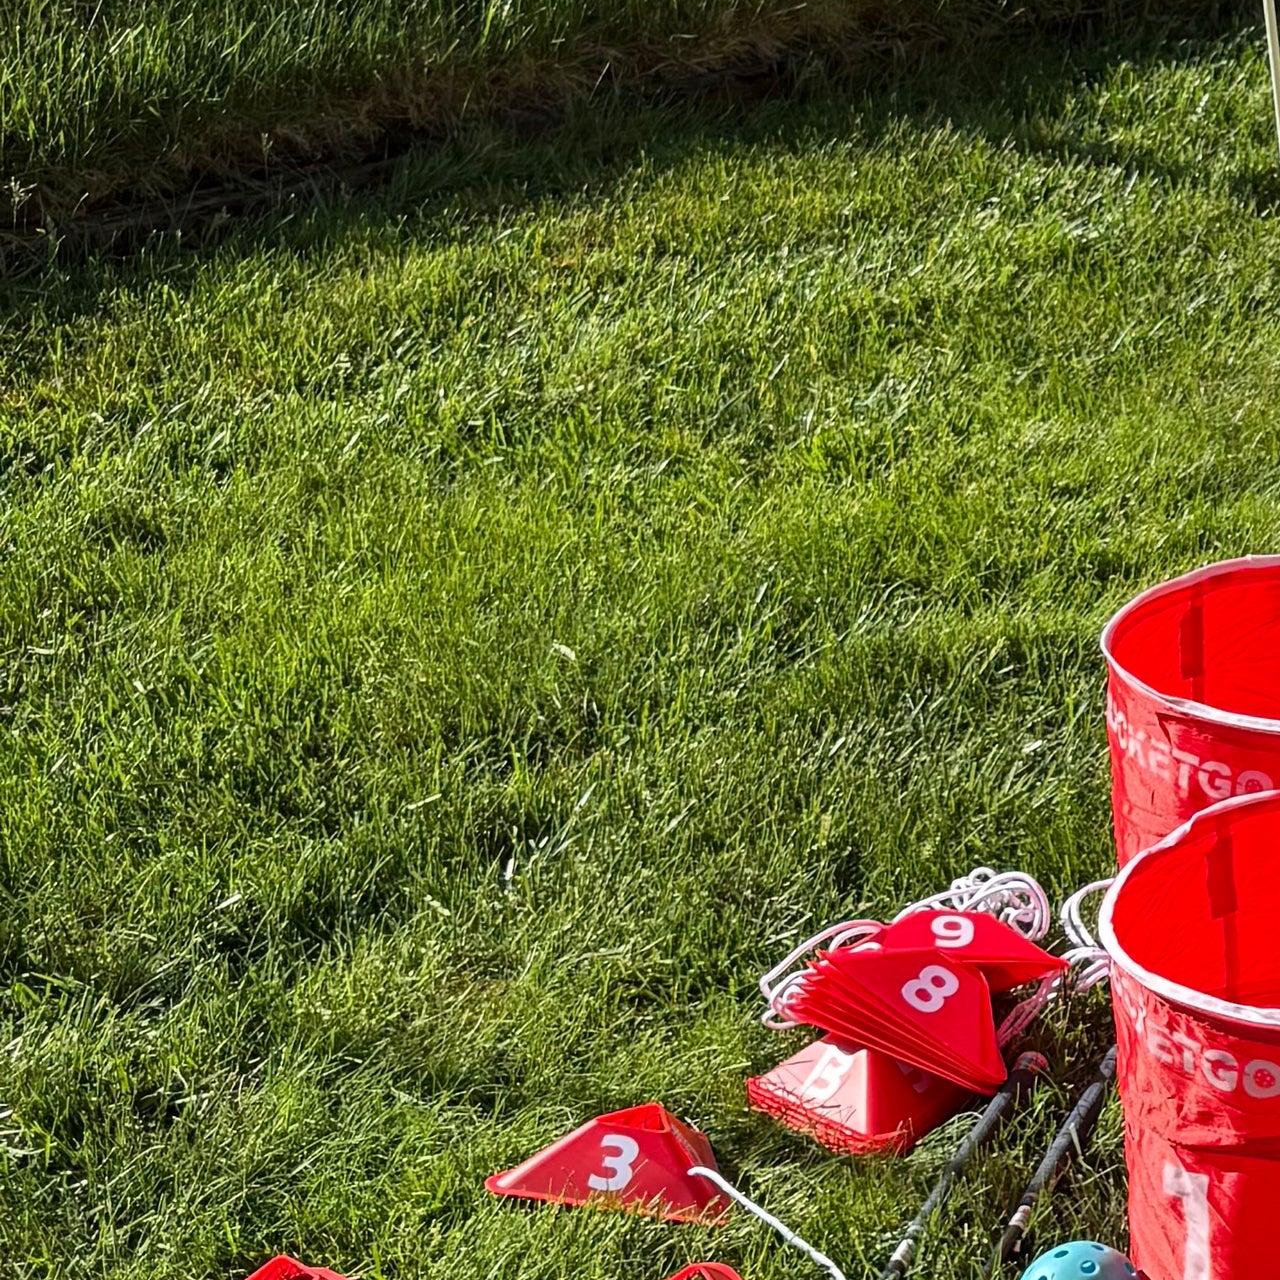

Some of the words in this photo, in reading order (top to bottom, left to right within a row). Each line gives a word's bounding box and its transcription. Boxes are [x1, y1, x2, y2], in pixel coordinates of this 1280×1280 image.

[931, 915, 974, 948] 9
[902, 965, 959, 1013] 8
[588, 1134, 639, 1192] 3
